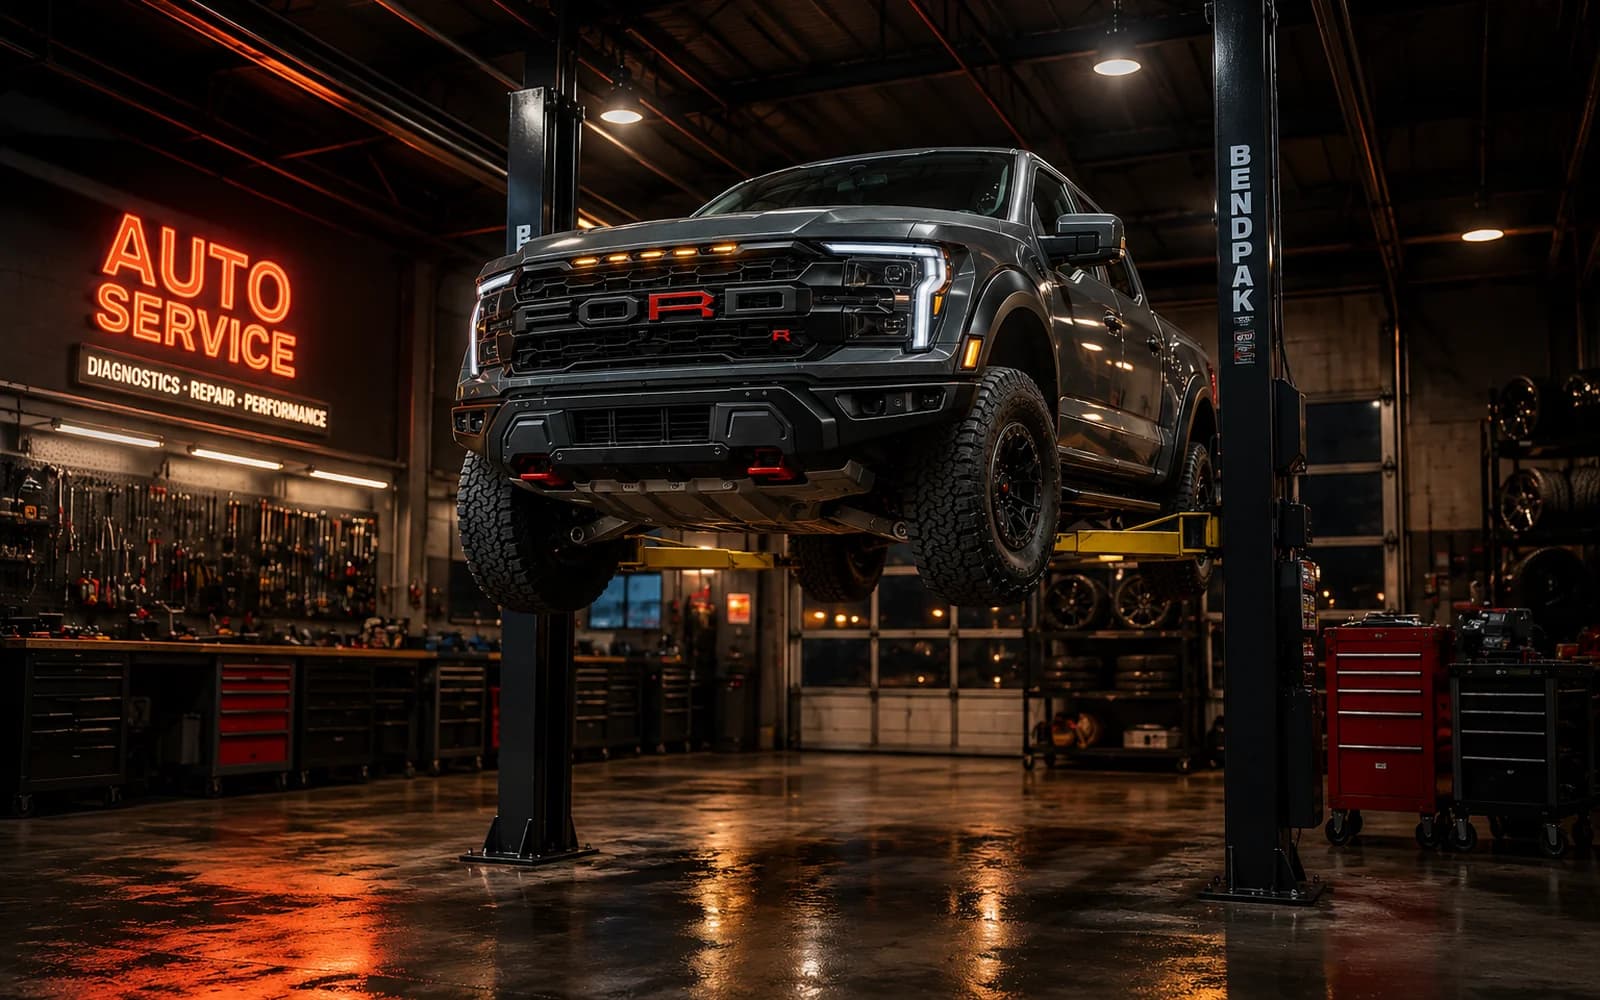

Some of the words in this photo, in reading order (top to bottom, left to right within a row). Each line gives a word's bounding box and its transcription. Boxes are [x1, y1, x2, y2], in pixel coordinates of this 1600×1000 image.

[102, 213, 291, 323] AUTO
[1230, 144, 1254, 313] BENDPAK
[97, 282, 296, 378] SERVICE
[512, 286, 798, 334] FORD
[772, 329, 791, 341] R
[87, 355, 181, 394] DIAGNOSTICS
[190, 380, 235, 407] REPAIR
[244, 393, 327, 428] PERFORMANCE
